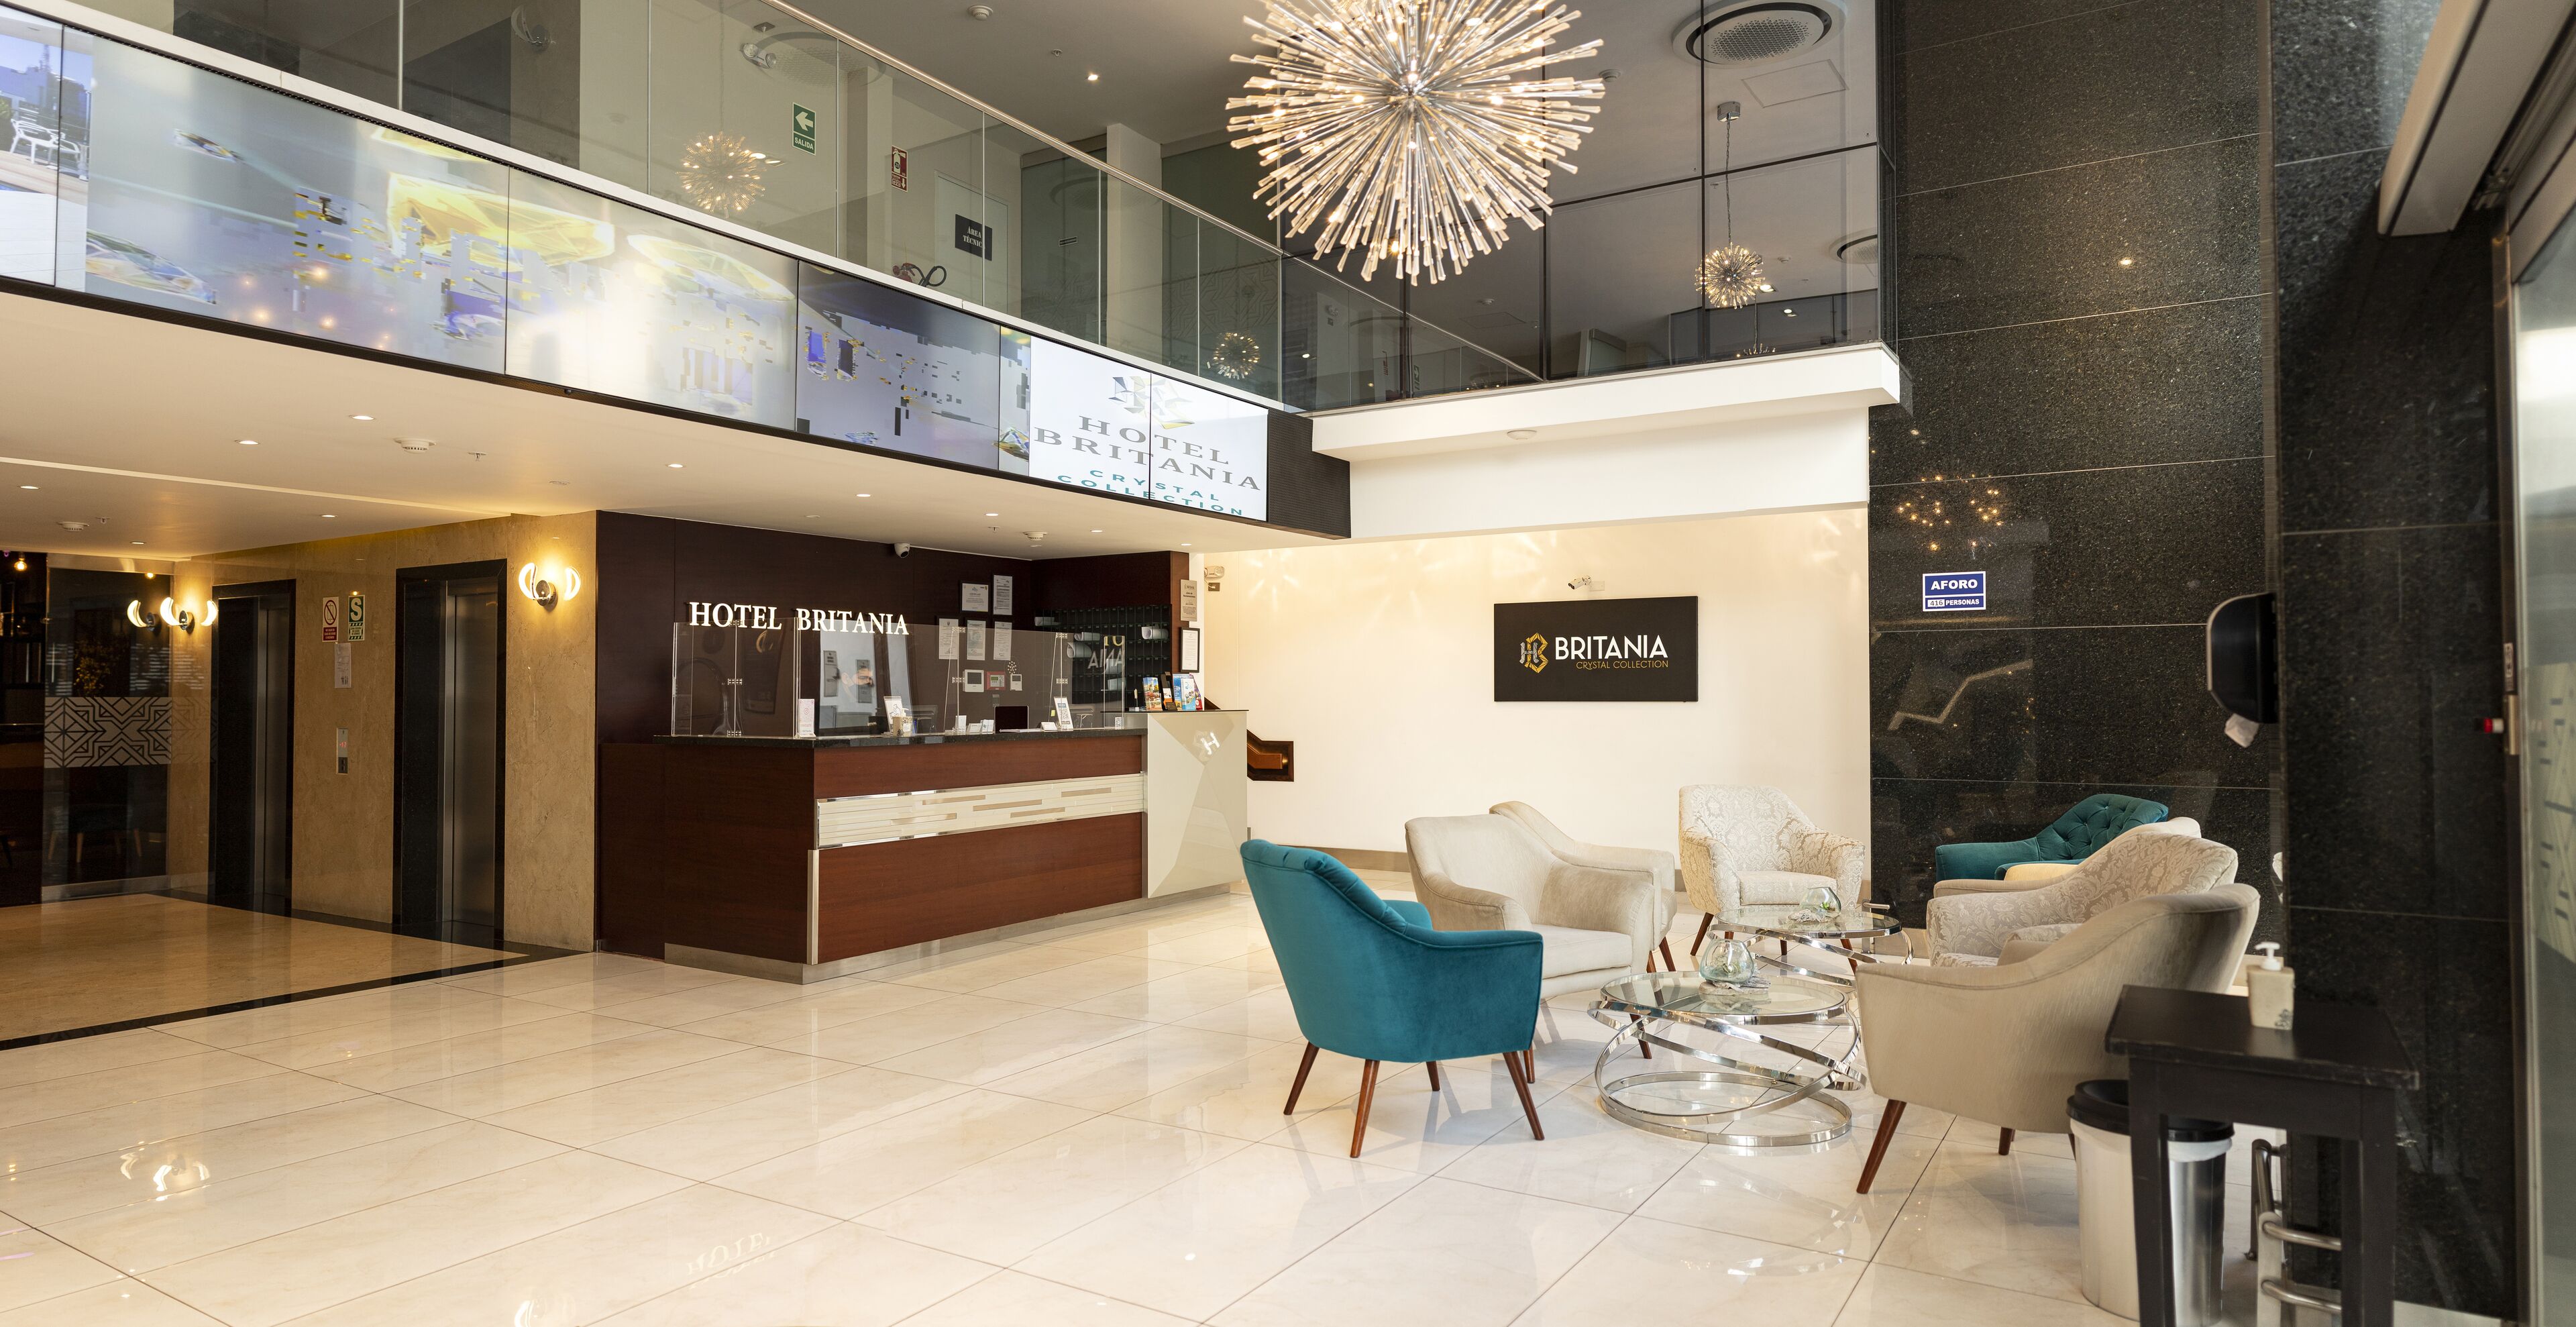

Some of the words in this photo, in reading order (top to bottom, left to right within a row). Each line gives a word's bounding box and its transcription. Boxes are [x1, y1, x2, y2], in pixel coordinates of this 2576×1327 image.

[794, 136, 814, 150] SALIDA
[967, 226, 981, 238] ÁREA
[1079, 415, 1228, 465] HOTEL
[1034, 427, 1260, 490] BRITANIA
[1057, 475, 1242, 515] COLLECTION
[1090, 470, 1219, 500] CRYSTAL
[1931, 579, 1978, 590] AFORO
[350, 597, 363, 621] S
[689, 602, 782, 629] HOTEL
[796, 608, 910, 635] BRITANIA
[1555, 635, 1668, 660] BRITANIA
[1576, 661, 1611, 670] CRYSTAL
[1613, 660, 1668, 669] COLLECTION
